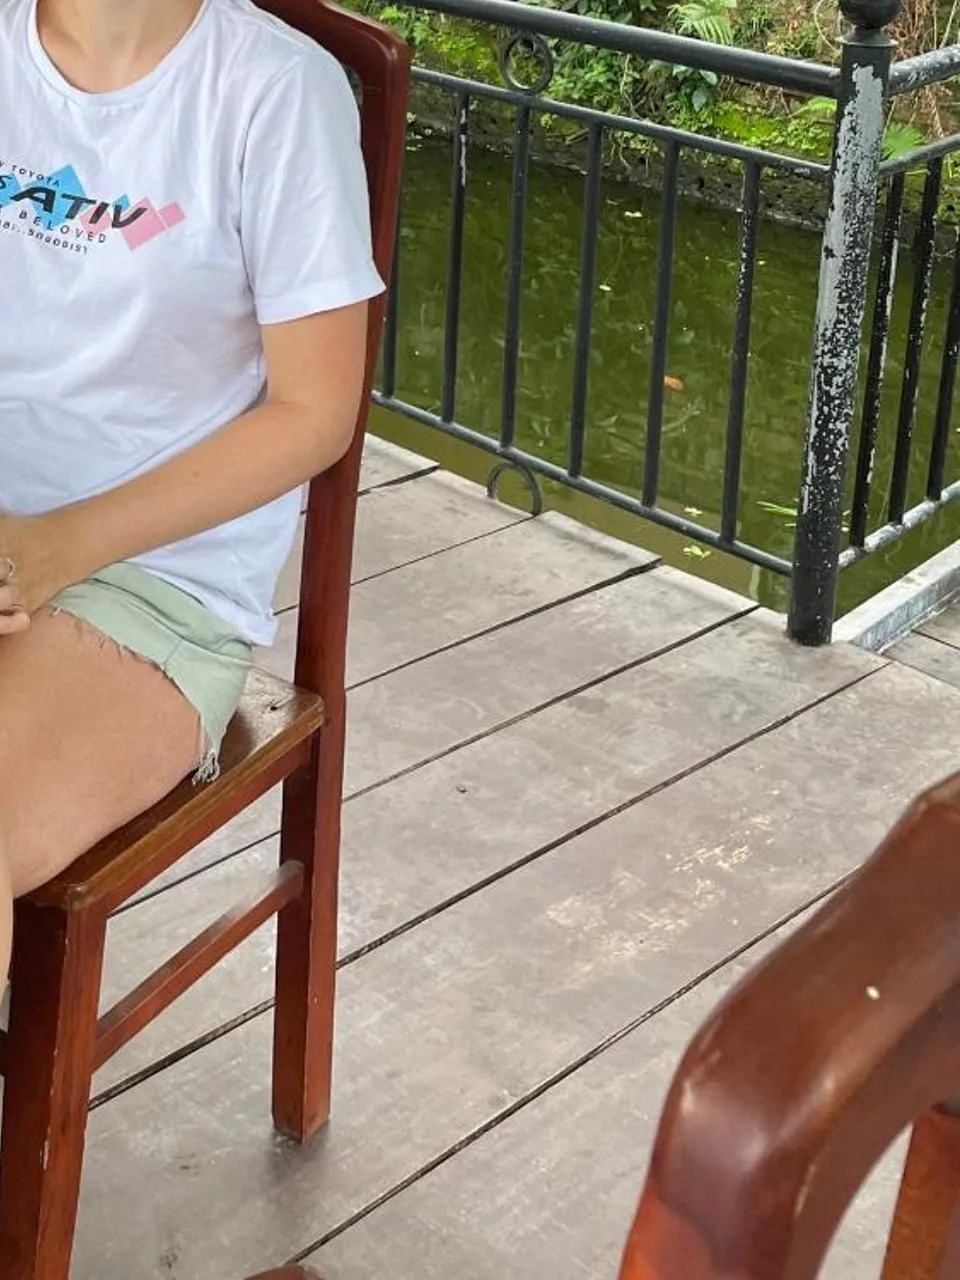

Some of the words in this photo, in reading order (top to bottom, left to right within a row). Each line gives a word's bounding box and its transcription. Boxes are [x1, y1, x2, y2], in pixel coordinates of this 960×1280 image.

[11, 165, 61, 188] TOYOTA
[9, 186, 148, 229] ATIV
[19, 210, 107, 243] BELOVED
